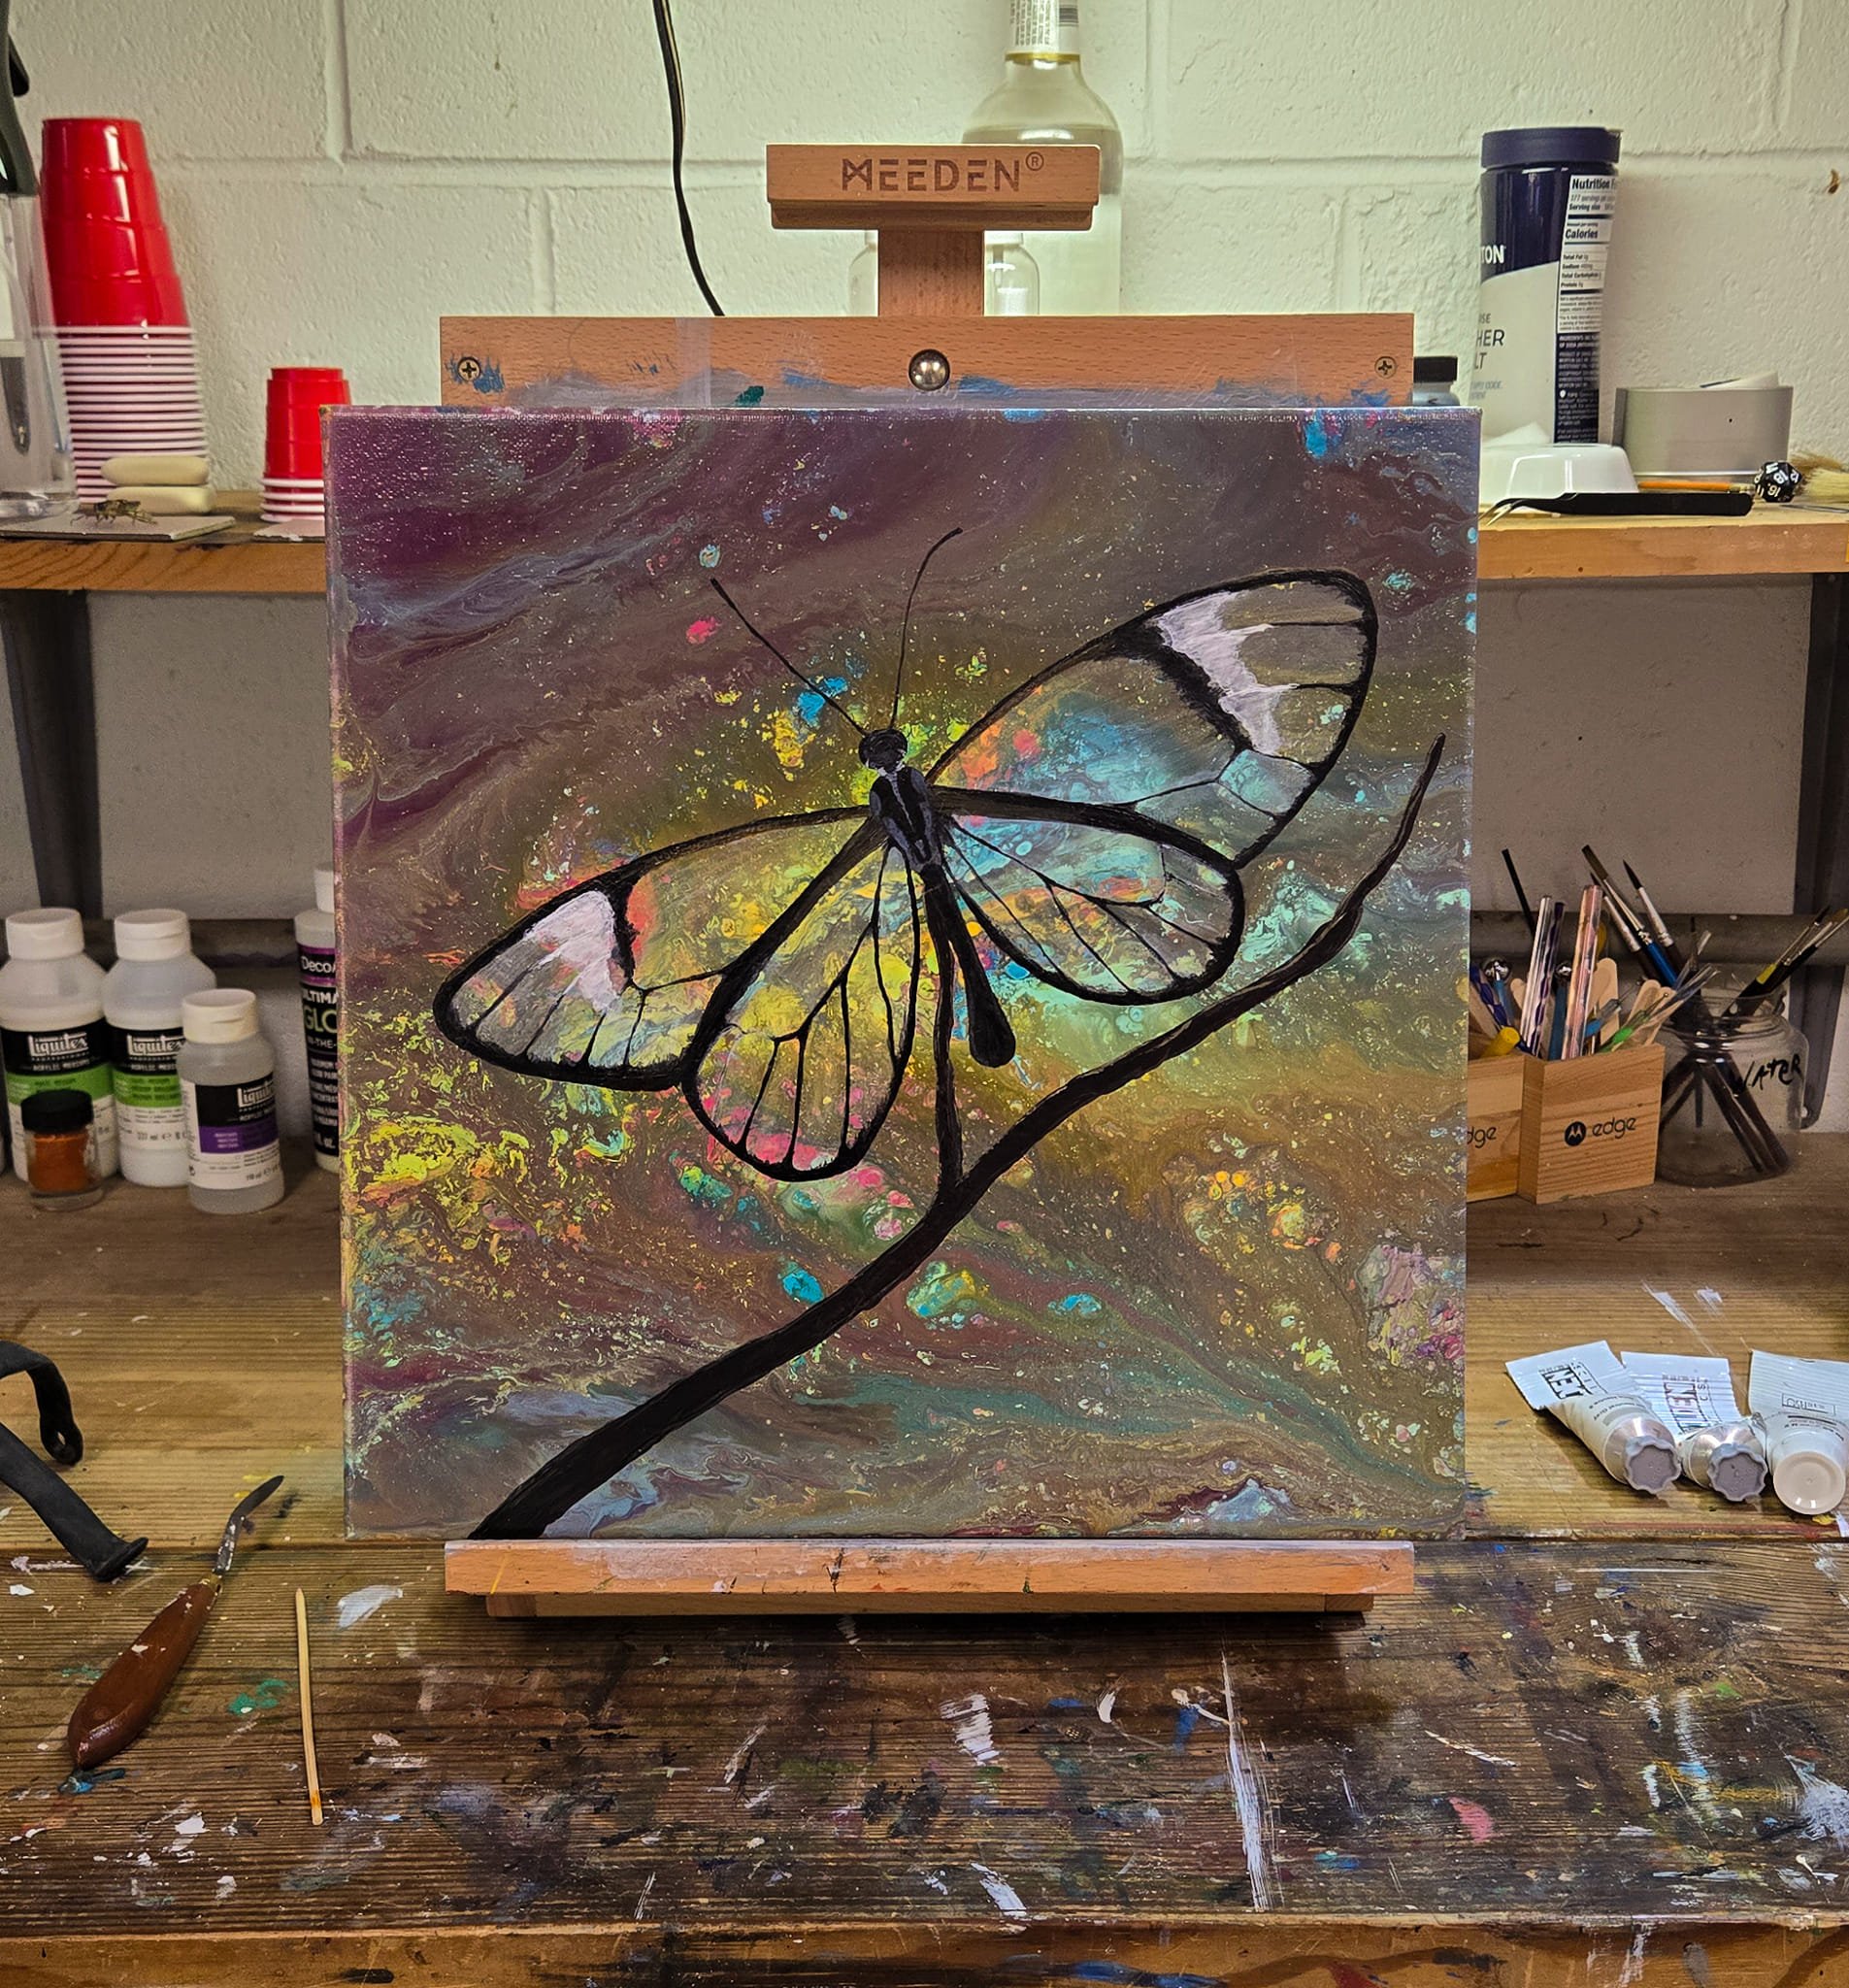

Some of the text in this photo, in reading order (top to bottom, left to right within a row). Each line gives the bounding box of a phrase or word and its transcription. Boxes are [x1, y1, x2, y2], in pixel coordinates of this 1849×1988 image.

[1572, 179, 1610, 189] Nutrition
[1565, 228, 1599, 239] Calories
[1476, 329, 1504, 348] HER
[1773, 470, 1789, 484] 18
[28, 1032, 88, 1057] Liquitex
[1468, 1126, 1497, 1148] dge
[1592, 1117, 1636, 1140] edge
